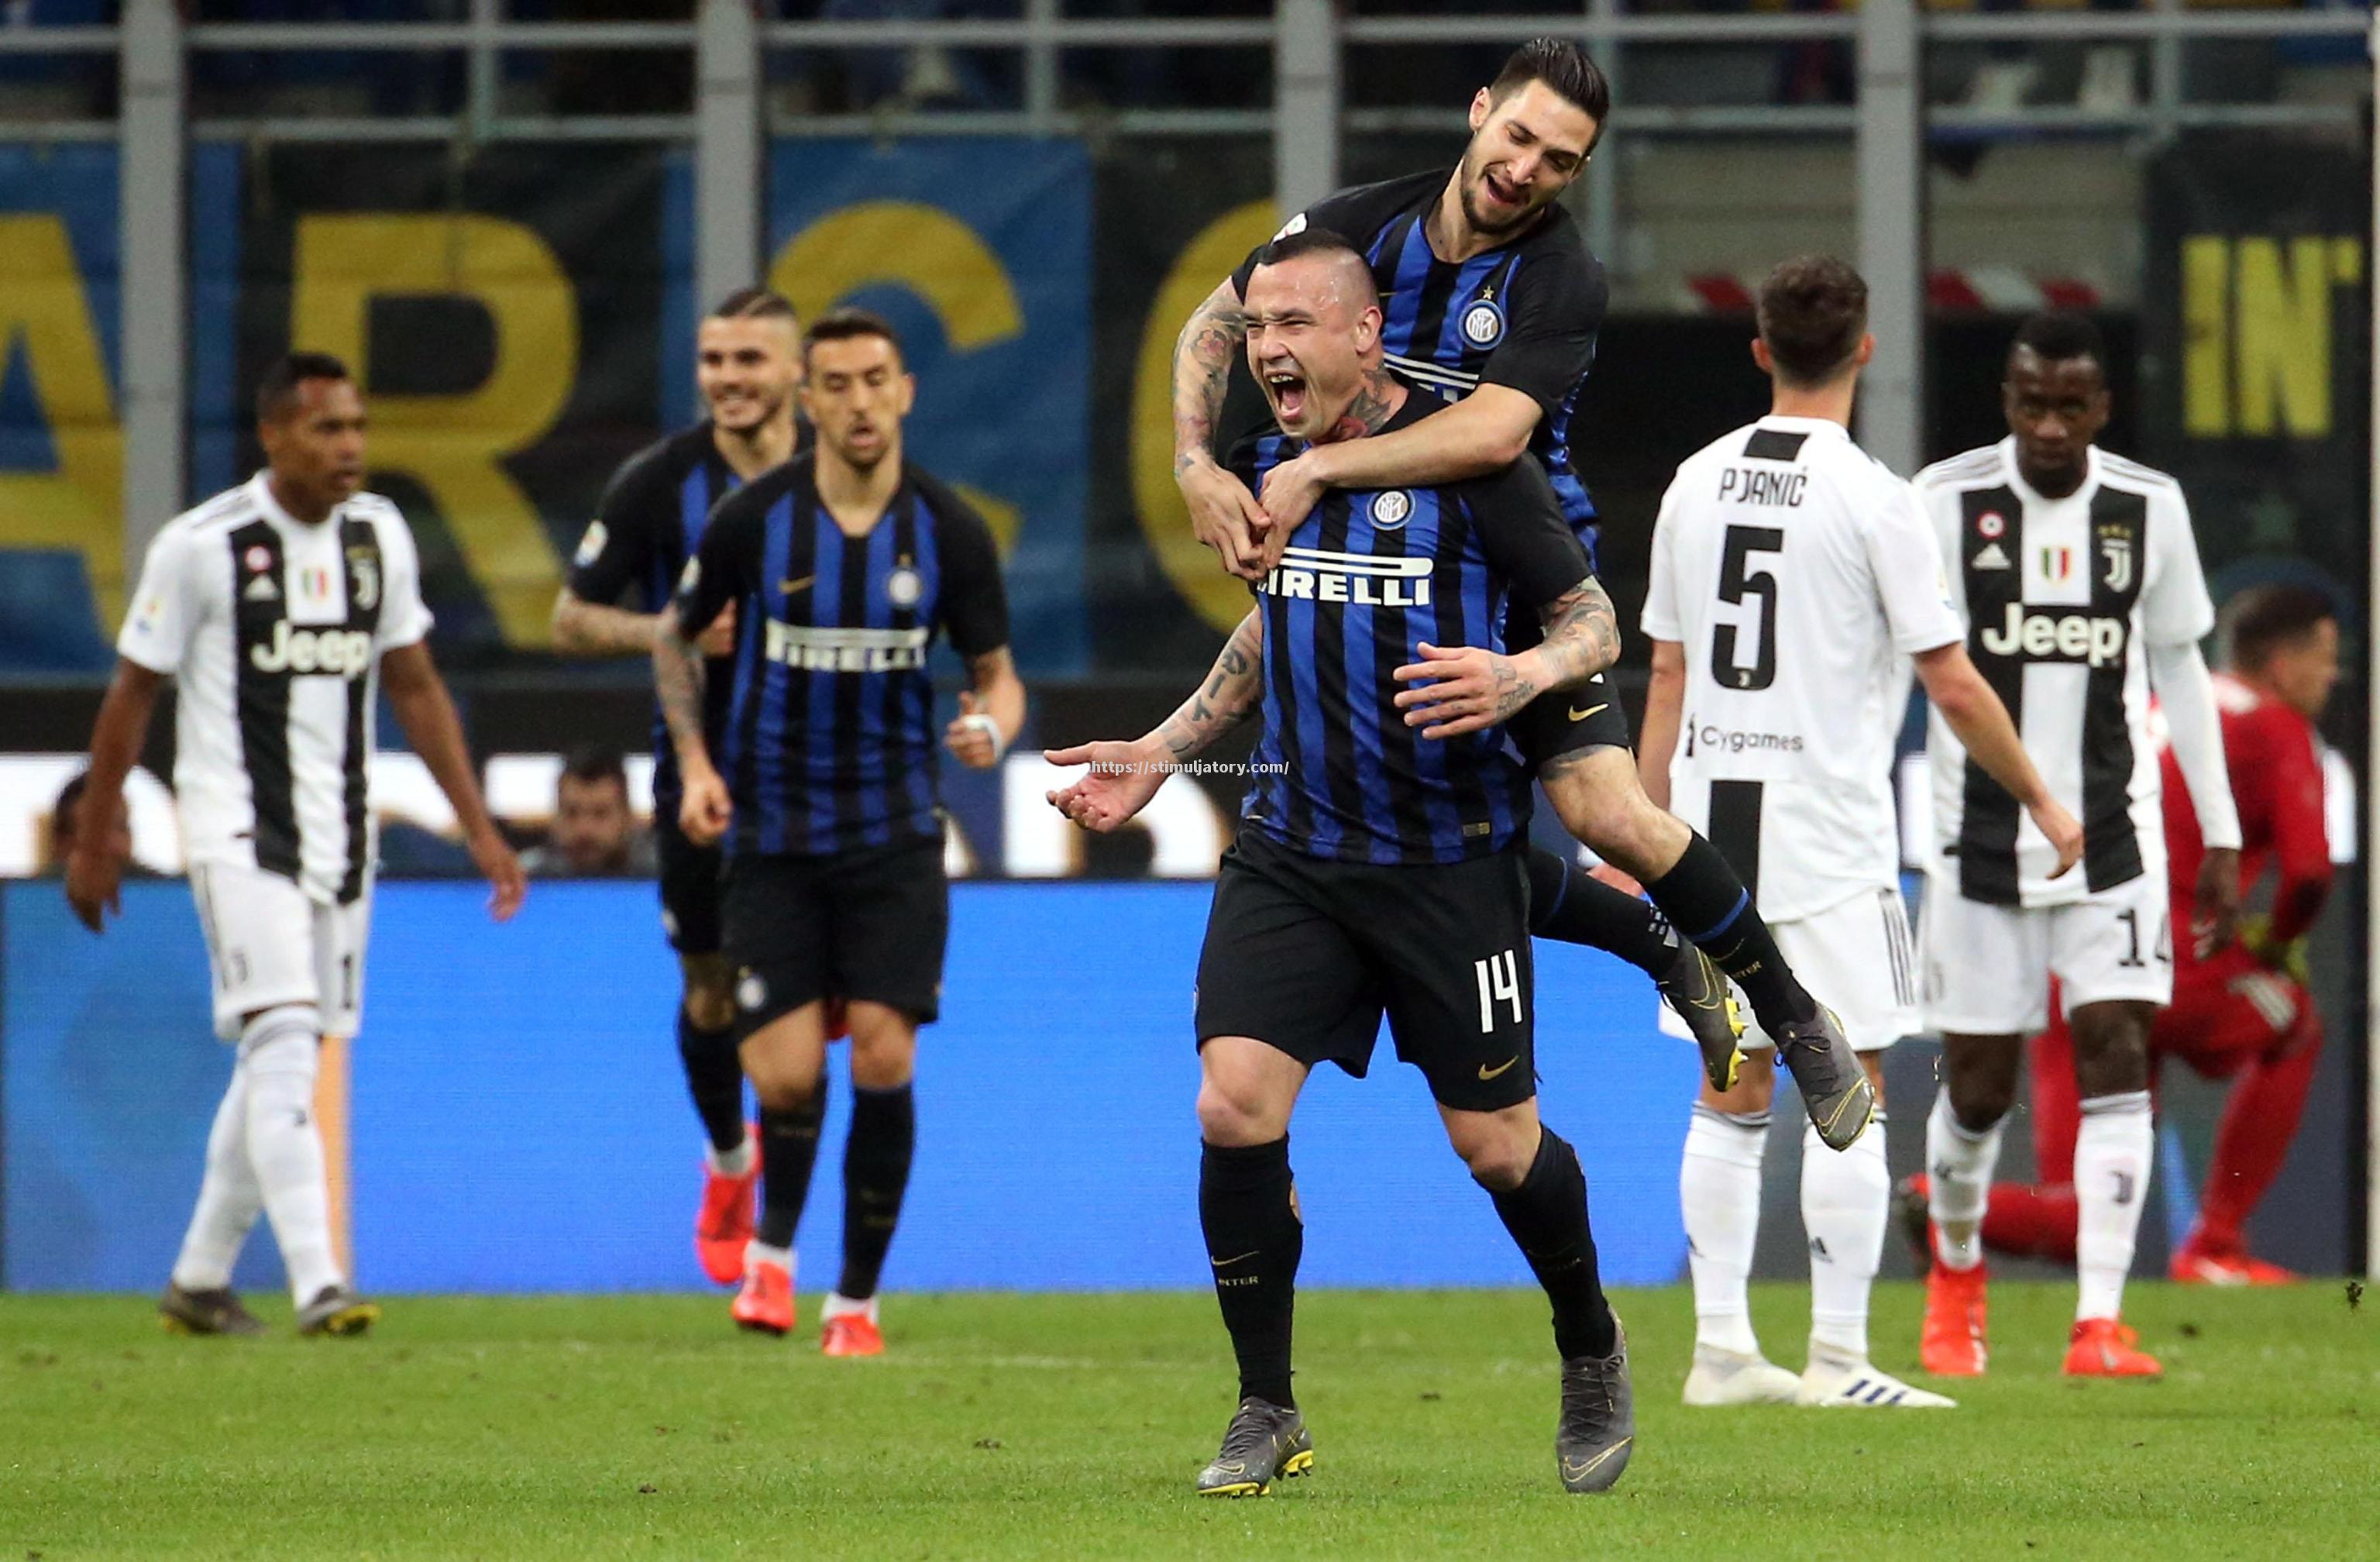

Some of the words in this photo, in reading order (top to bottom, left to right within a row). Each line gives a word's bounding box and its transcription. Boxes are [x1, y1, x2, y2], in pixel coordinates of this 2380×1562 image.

[1718, 466, 1808, 507] PJANIĆ
[1711, 524, 1783, 690] 5
[1981, 602, 2124, 668] Jeep
[250, 619, 372, 680] Jeep
[1701, 725, 1804, 752] Cygames
[1475, 950, 1522, 1034] 14
